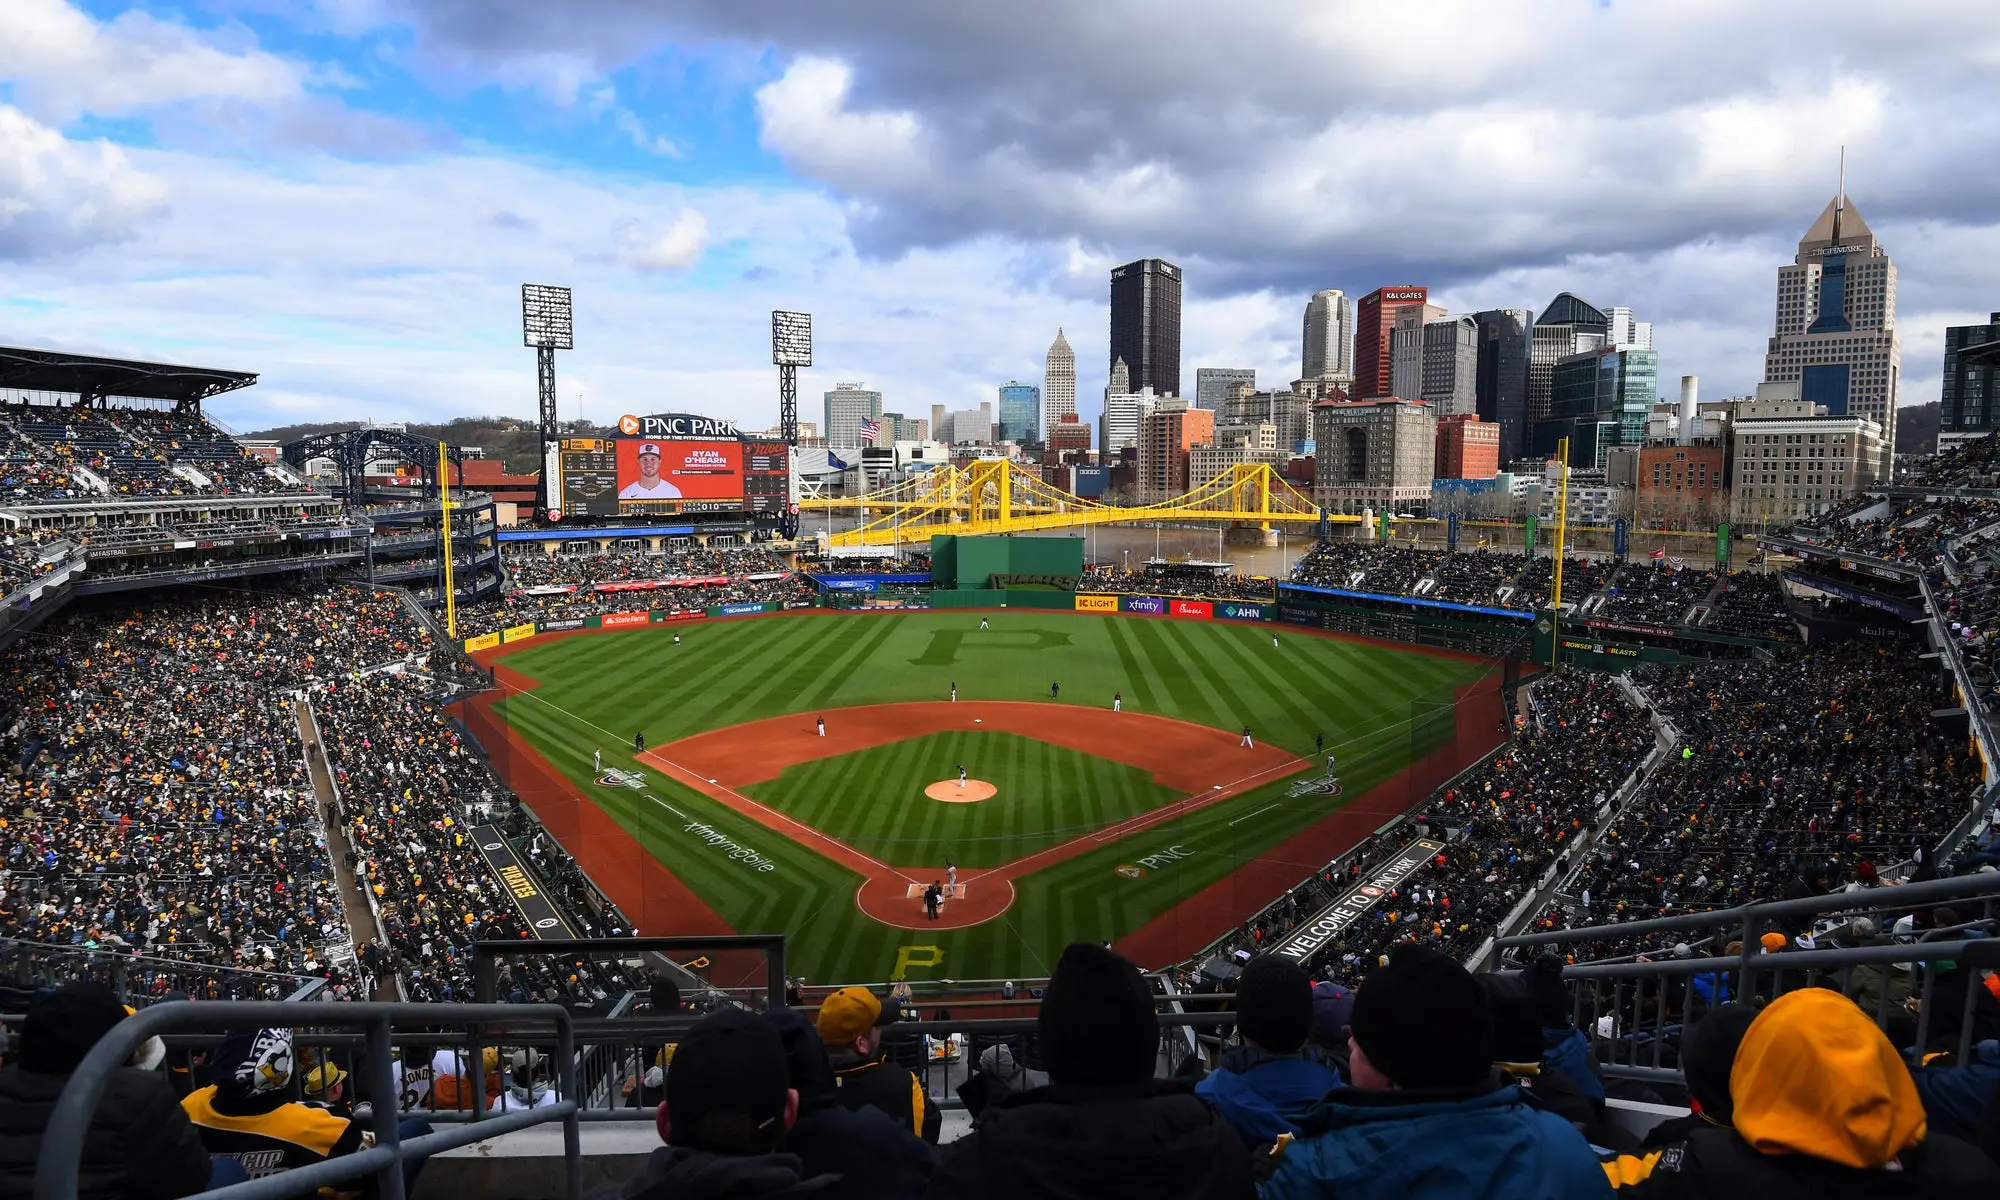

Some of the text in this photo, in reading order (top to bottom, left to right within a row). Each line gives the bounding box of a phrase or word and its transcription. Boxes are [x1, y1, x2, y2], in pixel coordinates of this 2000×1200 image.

[643, 418, 738, 436] PNC PARK
[606, 441, 614, 452] P
[99, 549, 127, 557] FASTBALL
[1090, 600, 1114, 608] LIGHT
[1129, 599, 1159, 612] xfinity
[1237, 608, 1260, 618] AHN
[1860, 626, 1885, 636] skull
[1566, 641, 1638, 657] BOWSER BLASTS
[1137, 845, 1195, 869] PNC
[1370, 855, 1420, 890] PNC PARK
[500, 865, 538, 899] PIRATES
[1280, 893, 1371, 958] WELCOME TO
[889, 945, 944, 981] P
[243, 1151, 283, 1168] CUP
